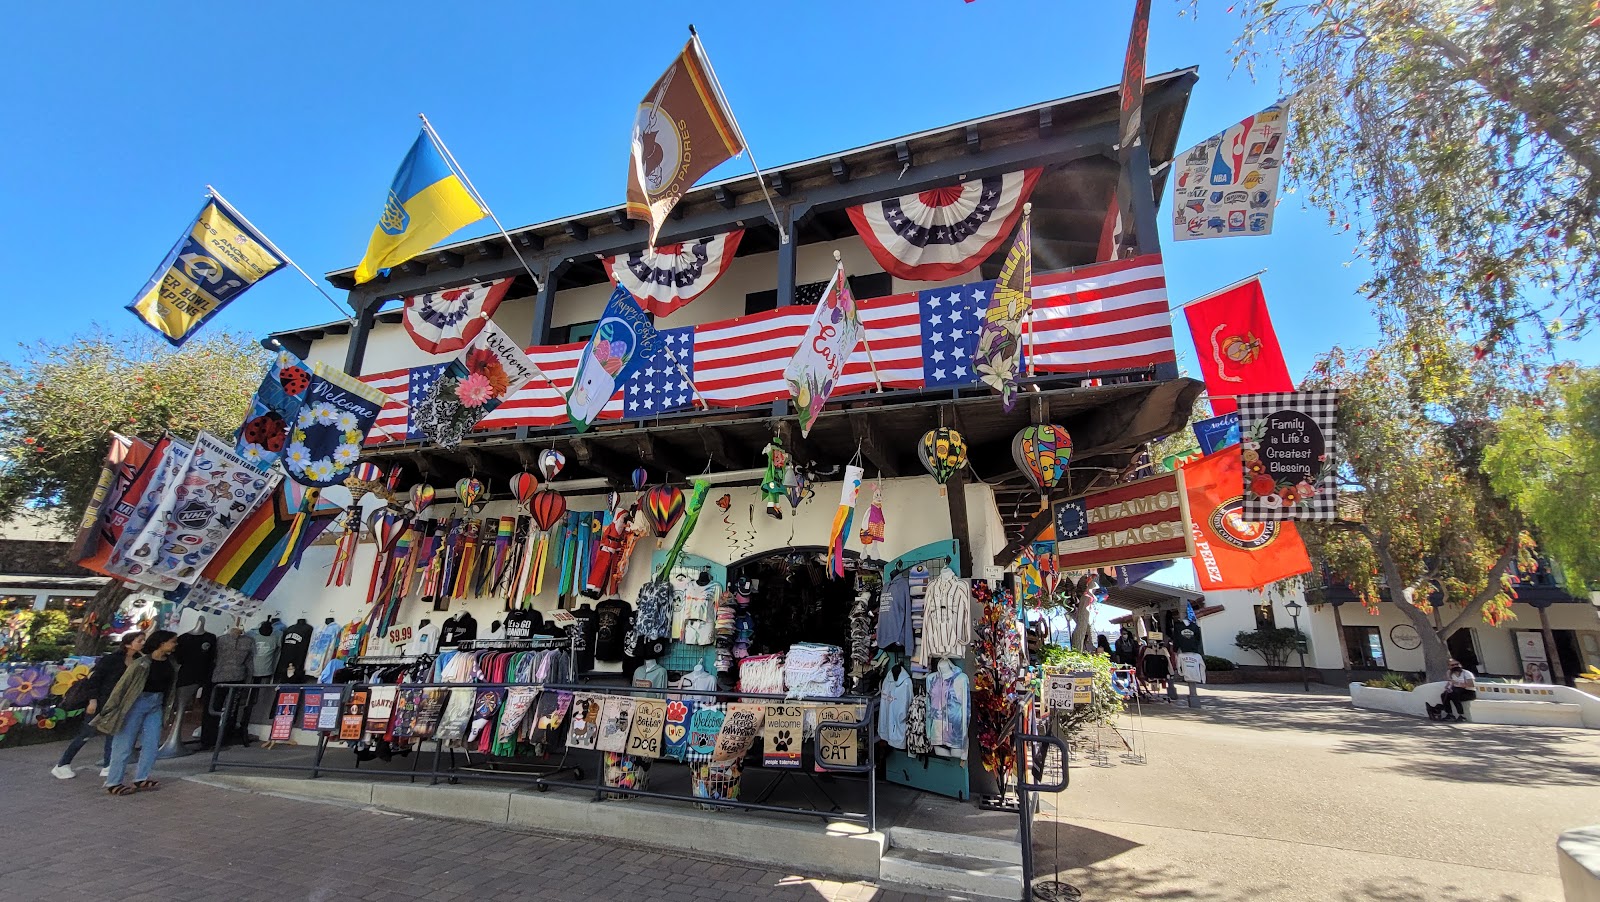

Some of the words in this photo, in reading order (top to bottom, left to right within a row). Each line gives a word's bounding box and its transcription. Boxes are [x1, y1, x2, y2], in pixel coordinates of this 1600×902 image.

[678, 119, 692, 181] PADRES
[1213, 174, 1228, 183] NBA
[198, 217, 218, 236] LOS
[220, 238, 265, 274] ANGELES
[211, 238, 241, 263] RAMS
[179, 287, 210, 311] BOWL
[611, 290, 640, 321] Happy
[483, 330, 532, 378] Welcome
[310, 380, 375, 418] Welcome
[1204, 415, 1240, 431] welco
[1271, 417, 1305, 432] Family
[1271, 435, 1279, 444] is
[1281, 431, 1311, 444] Life's
[199, 437, 211, 448] ASK
[211, 444, 223, 455] FOR
[223, 451, 241, 464] YOUR
[239, 459, 255, 473] TEAM
[254, 468, 271, 479] FLAG
[1266, 446, 1312, 459] Greatest
[1270, 461, 1311, 476] Blessing
[181, 510, 208, 521] NHL
[1091, 491, 1173, 523] ALAMO
[1096, 521, 1174, 550] FLAGS
[1196, 541, 1224, 583] PEREZ
[520, 620, 532, 629] GO
[389, 626, 412, 644] $9.99
[370, 698, 394, 708] GIANTS
[767, 706, 802, 717] DOGS
[768, 719, 801, 728] welcome
[632, 736, 657, 753] DOG
[820, 745, 851, 760] CAT
